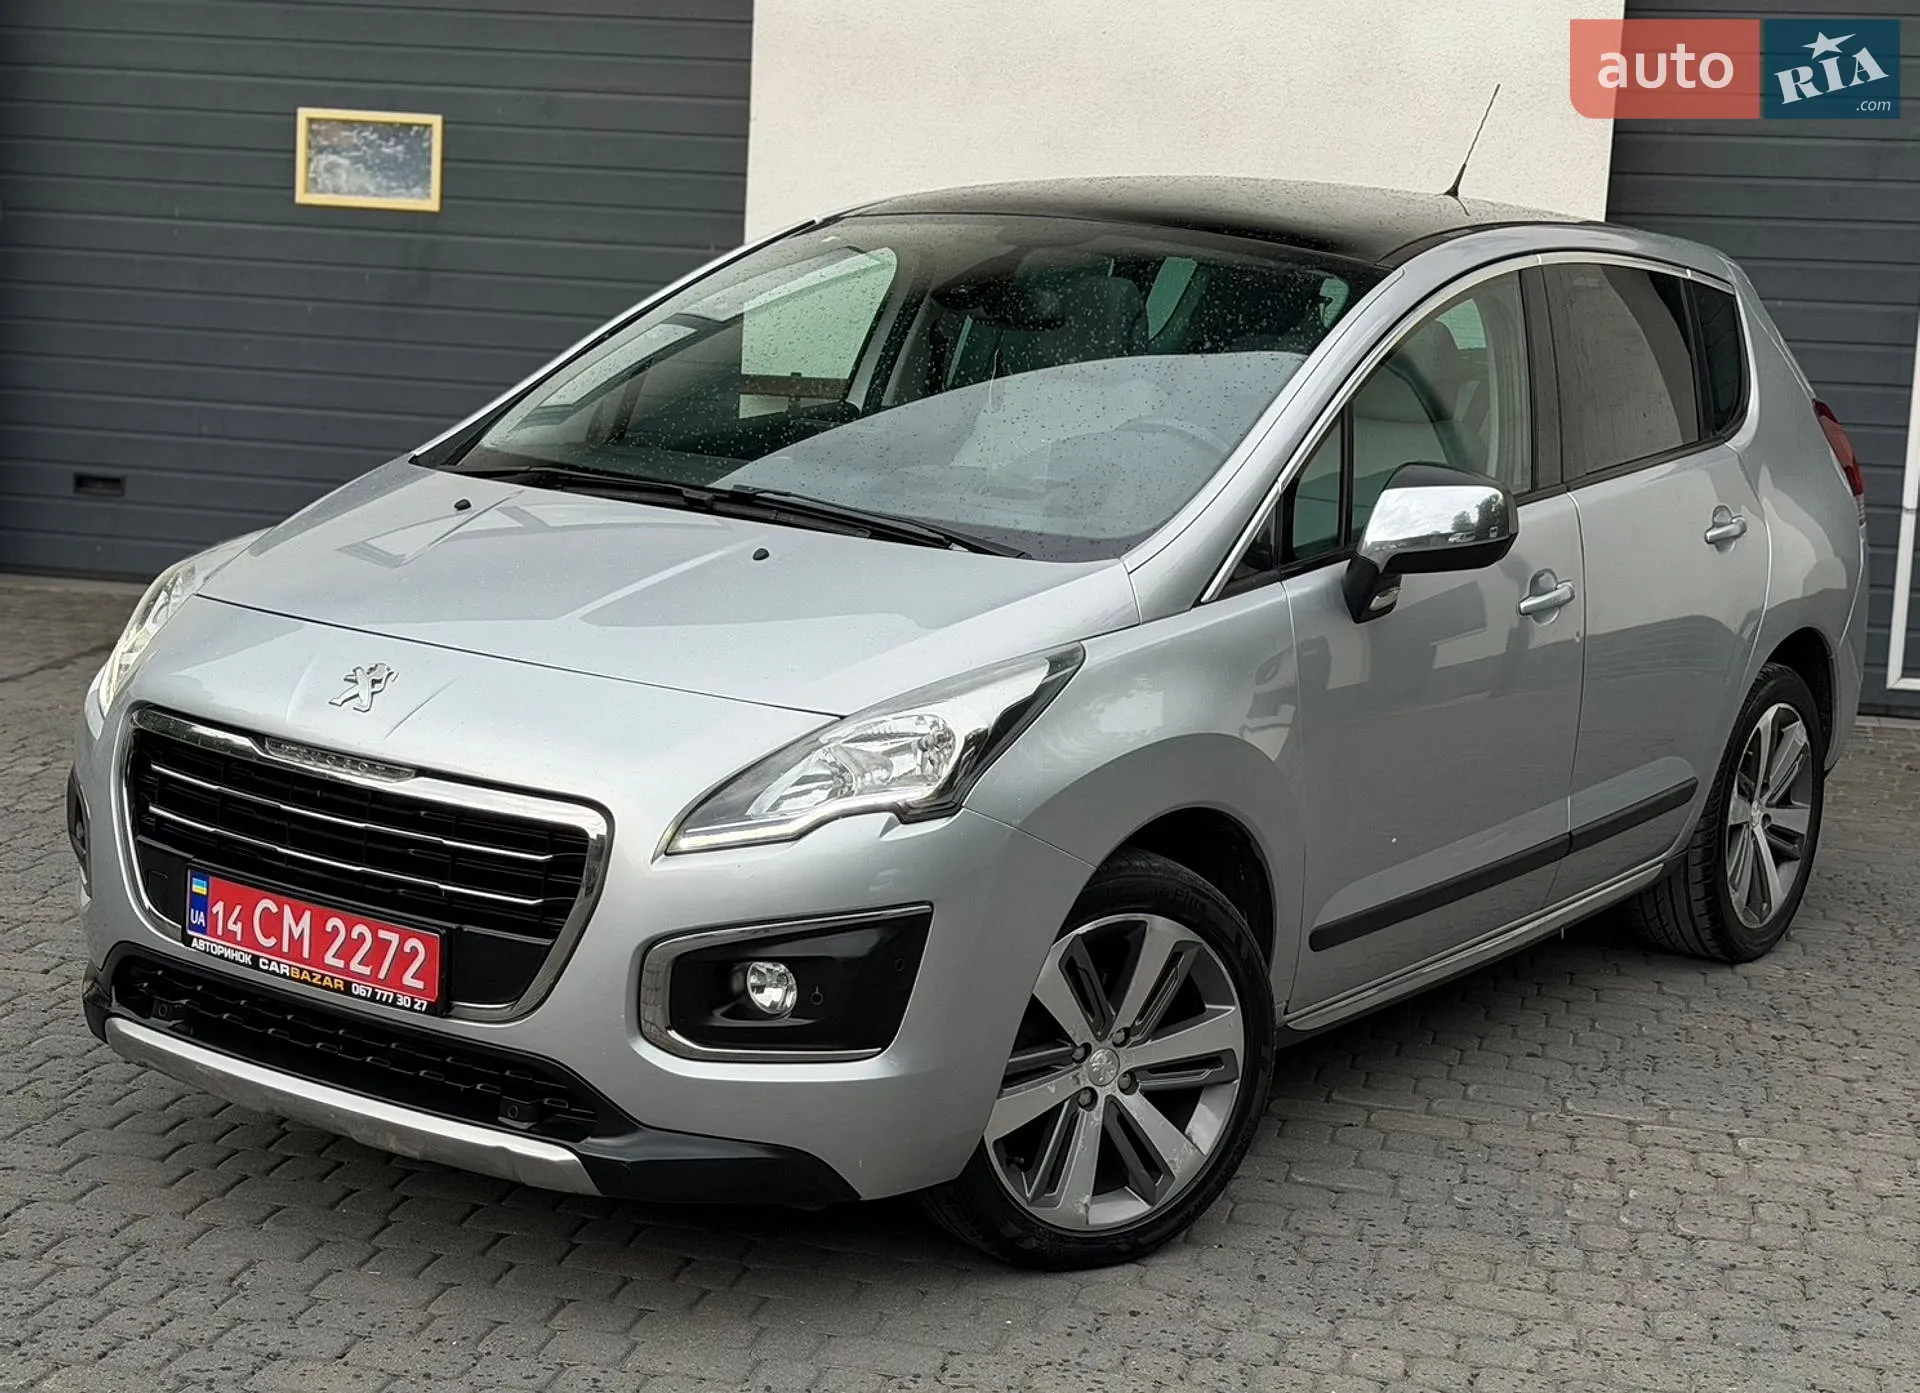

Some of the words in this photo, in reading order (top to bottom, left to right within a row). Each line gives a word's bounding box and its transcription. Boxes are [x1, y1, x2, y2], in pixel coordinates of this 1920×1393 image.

[190, 908, 206, 927] UA
[211, 900, 243, 941] 14
[252, 898, 312, 959] CM
[323, 916, 426, 990] 2272
[191, 937, 252, 966] АВТОРИНОК
[258, 958, 345, 991] CARBAZAR
[351, 982, 373, 998] 067
[374, 988, 394, 1003] 777
[396, 995, 411, 1008] 30
[413, 998, 428, 1012] 27
